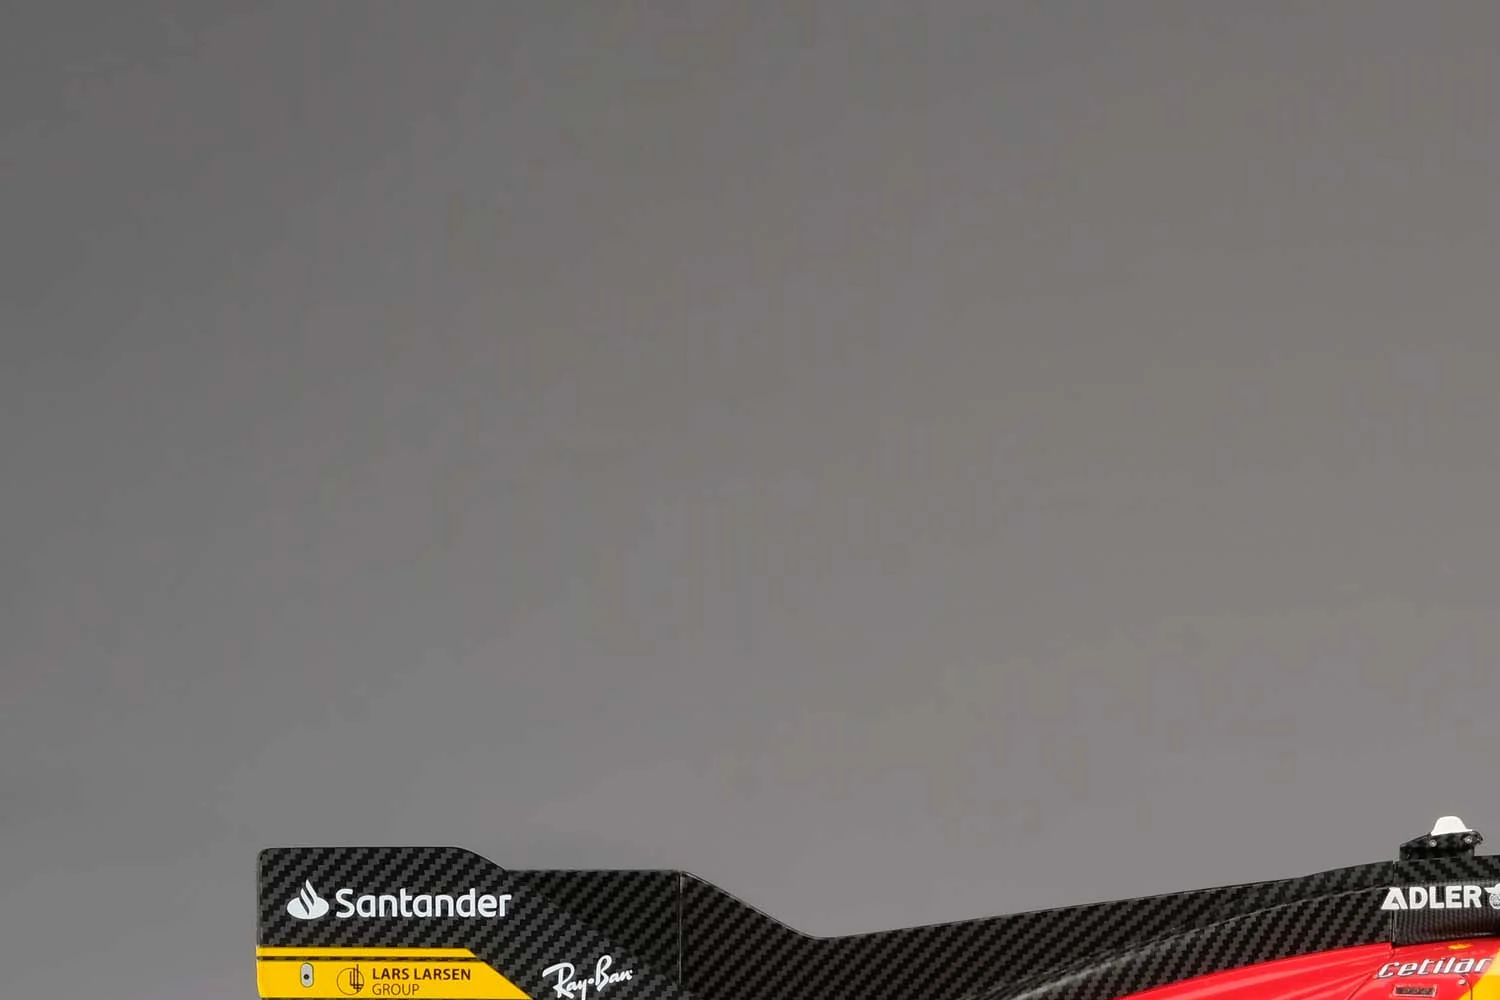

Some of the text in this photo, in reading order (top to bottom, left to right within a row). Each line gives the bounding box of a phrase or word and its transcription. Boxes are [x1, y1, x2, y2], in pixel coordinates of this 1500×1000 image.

[335, 888, 512, 918] Santander
[1381, 885, 1482, 910] ADLER
[372, 968, 471, 981] LARS LARSEN
[372, 984, 419, 996] GROUP
